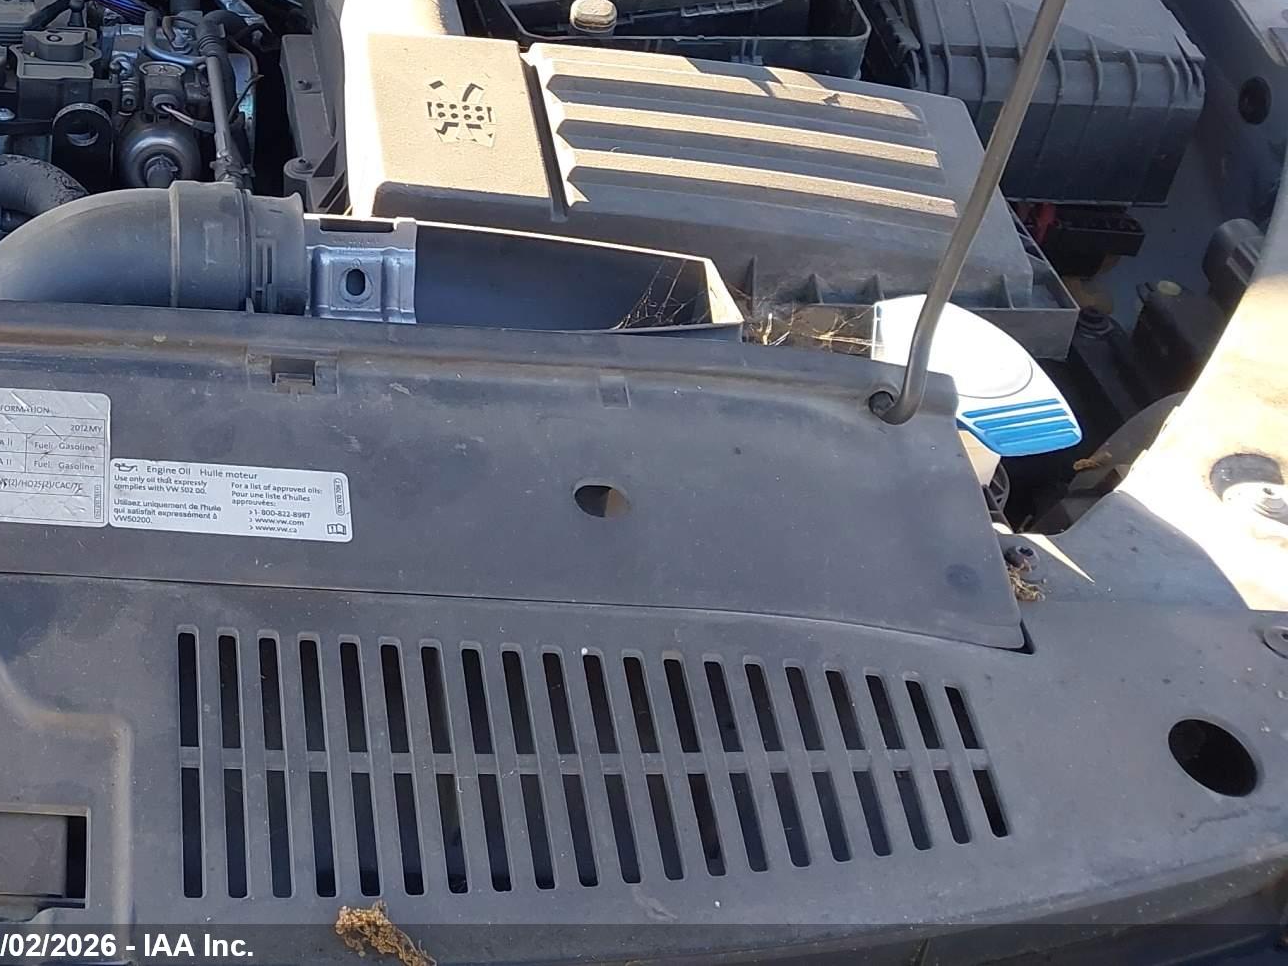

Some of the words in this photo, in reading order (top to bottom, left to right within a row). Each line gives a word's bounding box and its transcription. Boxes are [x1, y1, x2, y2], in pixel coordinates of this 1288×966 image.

[58, 442, 96, 451] Gasoline
[58, 461, 95, 471] Gasoline
[146, 465, 176, 475] Engine
[178, 467, 191, 475] Oil
[199, 468, 223, 477] Huile
[225, 471, 258, 480] moteur
[129, 476, 145, 484] only
[173, 479, 207, 488] expressly
[114, 483, 146, 491] complies
[272, 485, 306, 493] approved
[231, 490, 248, 498] Pour
[282, 493, 311, 502] d'huiles
[113, 498, 142, 506] Utilisez
[143, 501, 187, 509] uniquement
[158, 510, 210, 519] expressément
[255, 518, 304, 526] www.vw.com
[255, 525, 297, 533] www.vw.ca
